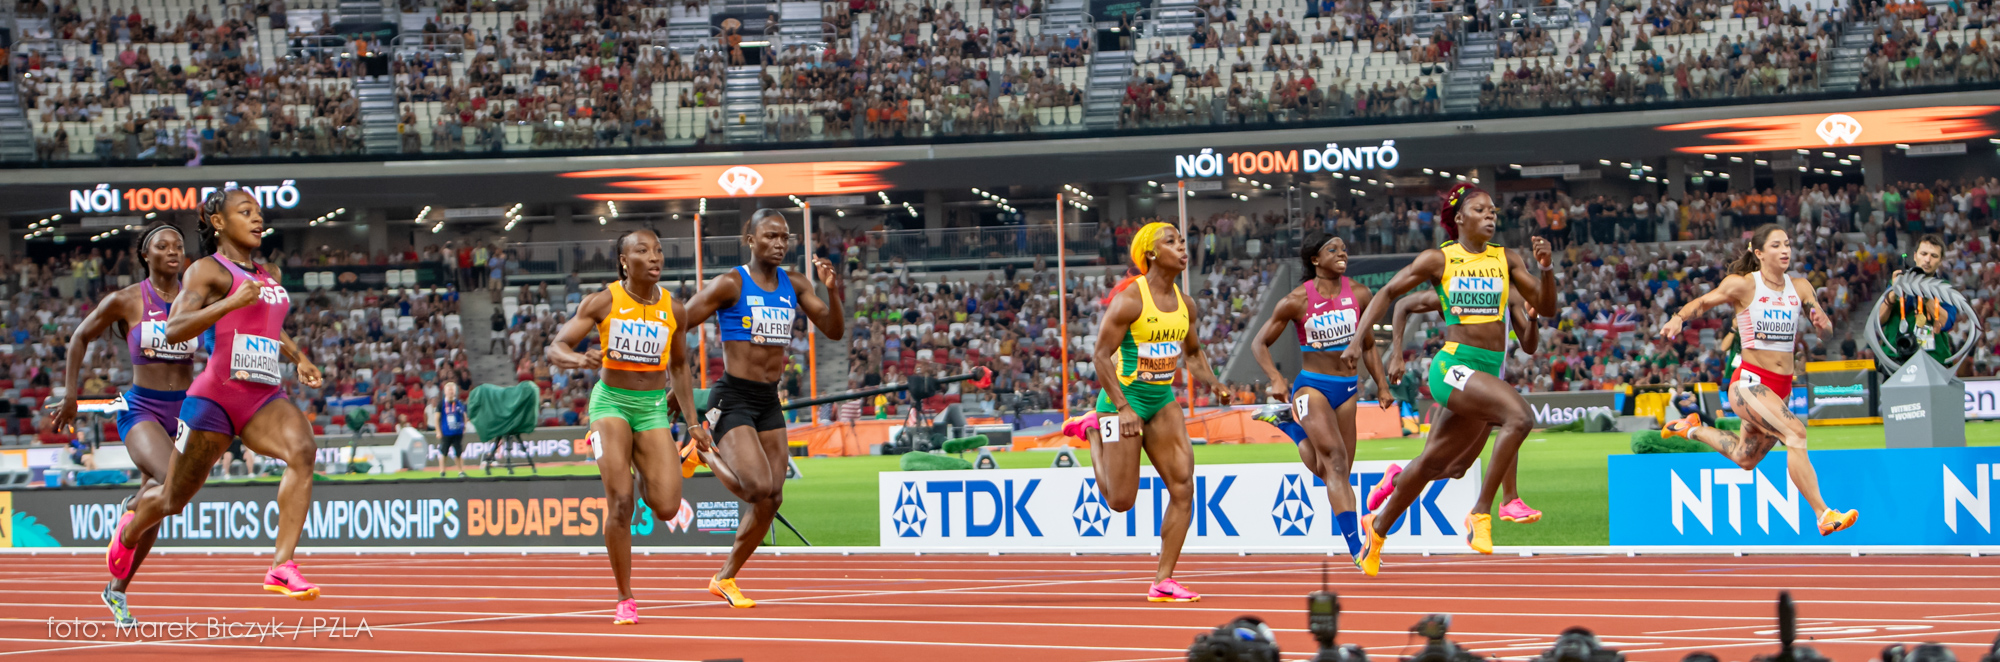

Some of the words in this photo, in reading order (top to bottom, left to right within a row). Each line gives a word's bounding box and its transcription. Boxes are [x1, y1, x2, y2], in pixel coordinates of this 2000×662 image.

[1175, 148, 1223, 178] NŐI
[1228, 150, 1299, 174] 100M
[1303, 139, 1399, 173] DÖNTŐ
[70, 183, 121, 213] NŐI
[124, 187, 197, 211] 100M
[1458, 278, 1493, 290] NTN
[1450, 292, 1499, 305] JACKSON
[761, 308, 789, 321] NTN
[1313, 312, 1345, 329] NTN
[1763, 309, 1791, 320] NTN
[621, 321, 658, 339] NTN
[1311, 324, 1351, 340] BROWN
[152, 337, 188, 351] DAVIS
[246, 336, 278, 355] NTN
[614, 336, 630, 351] TA
[635, 339, 660, 354] LOU
[1150, 343, 1177, 356] NTN
[1452, 369, 1465, 381] 4
[1890, 403, 1921, 413] WITNESS
[1895, 410, 1926, 420] WONDER
[1105, 420, 1112, 438] 5
[714, 501, 739, 509] ATHLETICS
[926, 478, 1044, 537] TDK
[1671, 467, 1800, 536] NTN
[263, 498, 460, 540] CAMPIONSHIPS
[696, 509, 739, 518] CHAMPIONSHIPS
